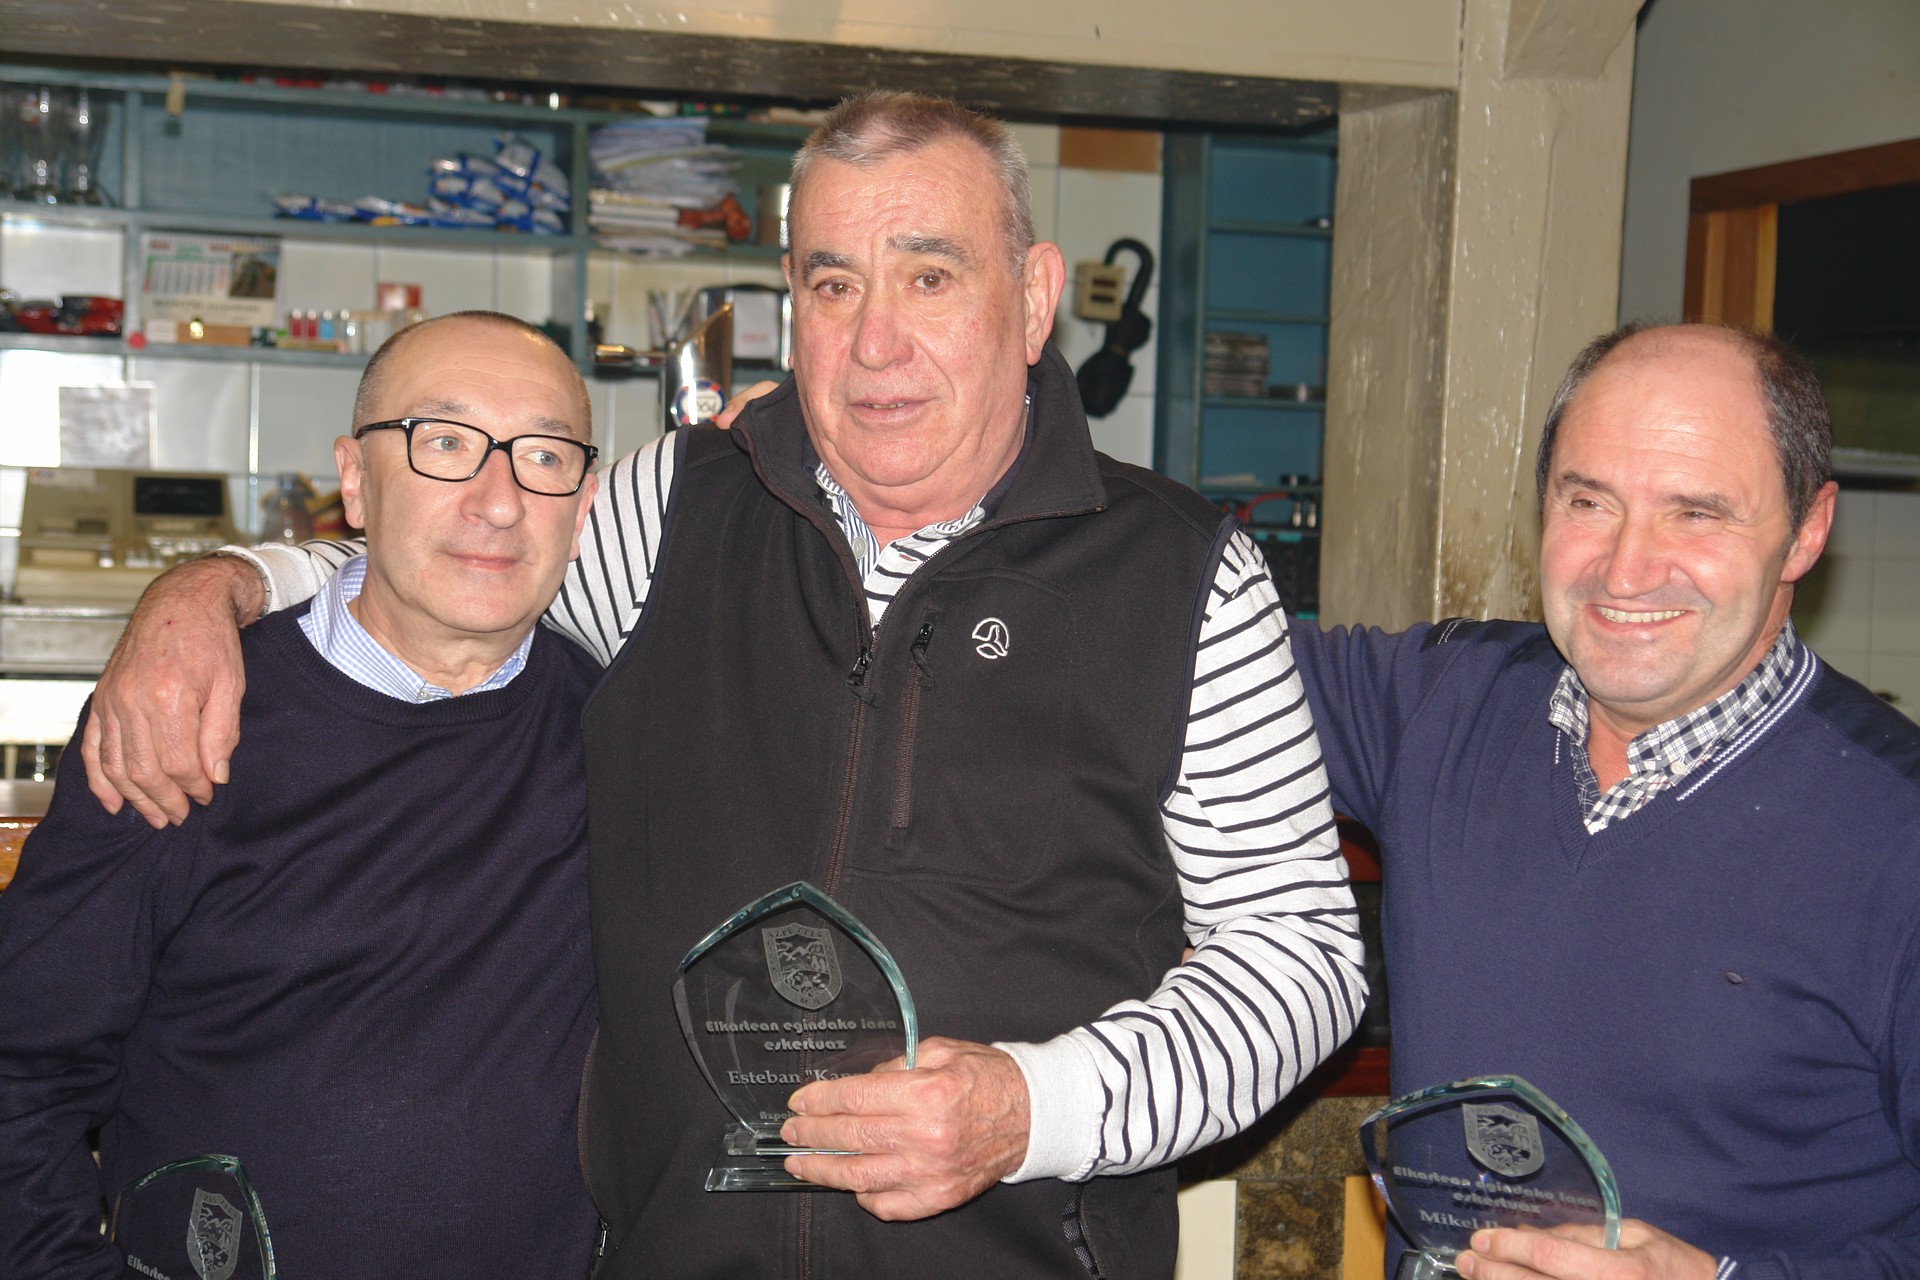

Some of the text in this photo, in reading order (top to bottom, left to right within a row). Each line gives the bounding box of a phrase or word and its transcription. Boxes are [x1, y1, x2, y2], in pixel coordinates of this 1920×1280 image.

[705, 1018, 897, 1034] Elkartean egindako lana
[763, 1037, 847, 1051] eskertuaz
[728, 1069, 801, 1085] Esteban
[1393, 1166, 1471, 1187] Elkartean
[1558, 1191, 1599, 1207] lana
[1419, 1209, 1479, 1230] Mikel
